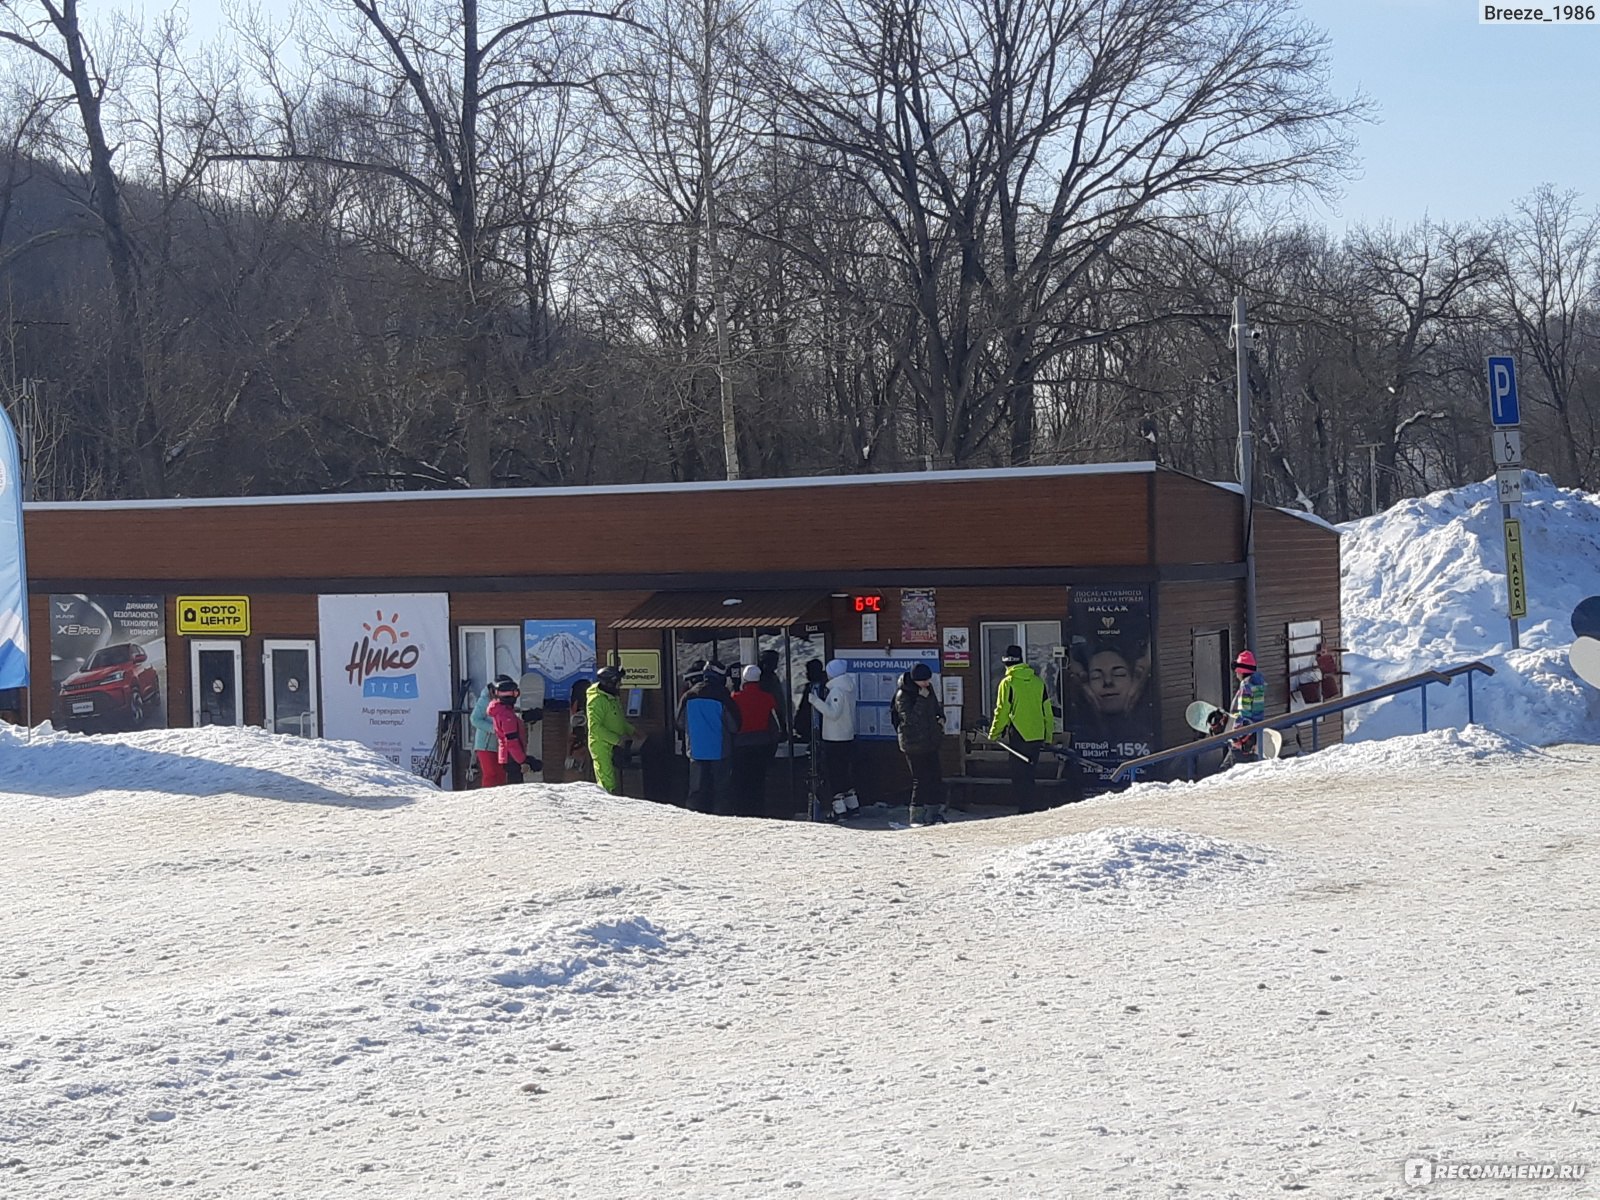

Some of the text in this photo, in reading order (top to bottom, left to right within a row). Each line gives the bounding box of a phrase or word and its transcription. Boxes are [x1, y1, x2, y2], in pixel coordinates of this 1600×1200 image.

[1494, 364, 1511, 417] P
[1511, 552, 1522, 610] КАССА
[120, 619, 159, 627] ТЕХНОЛОГИИ
[200, 616, 241, 626] ЦЕНТР
[129, 628, 158, 636] КОМФОРТ
[1074, 741, 1109, 750] ПЕРВЫЙ
[1110, 742, 1151, 757] -15%
